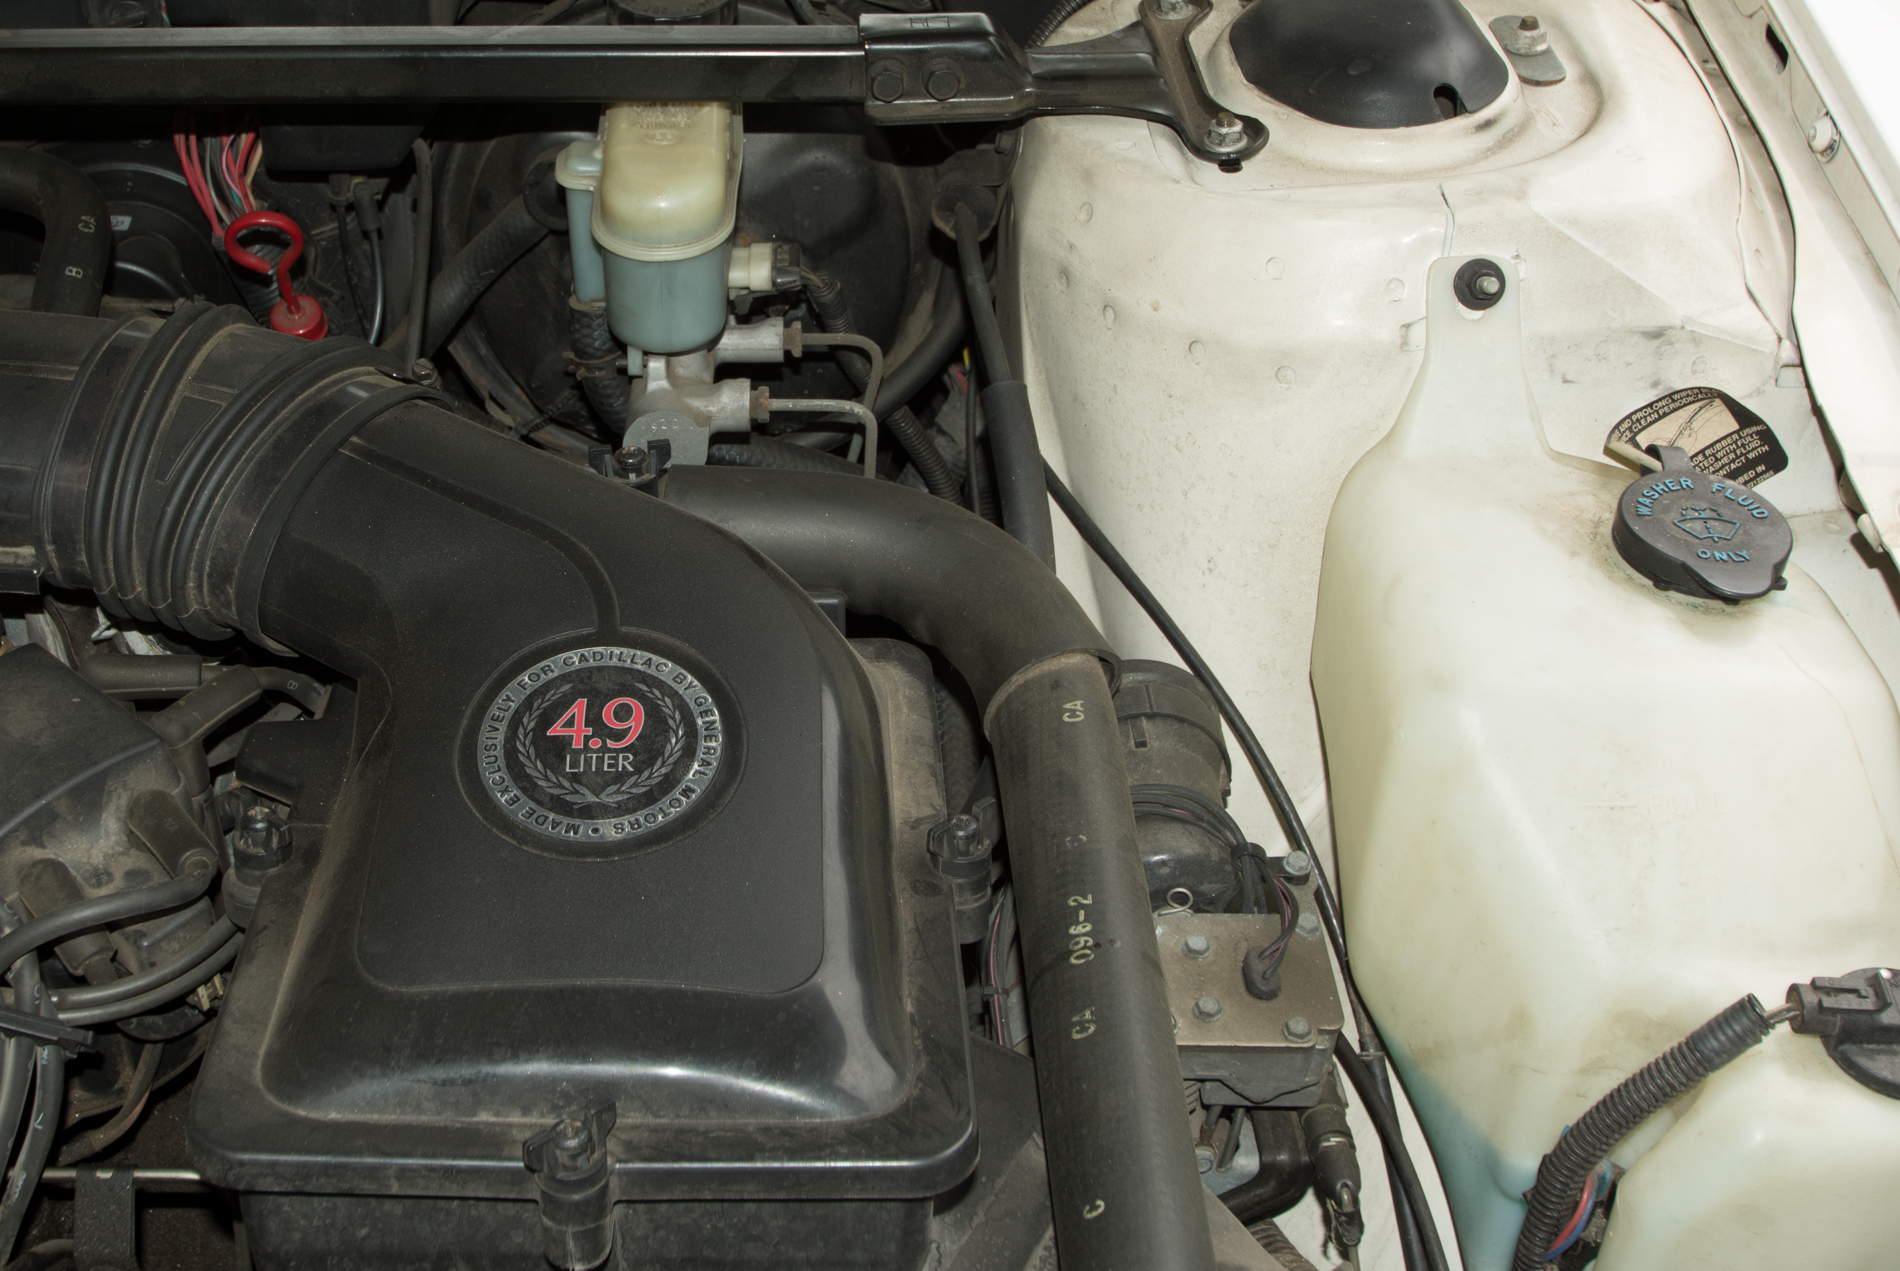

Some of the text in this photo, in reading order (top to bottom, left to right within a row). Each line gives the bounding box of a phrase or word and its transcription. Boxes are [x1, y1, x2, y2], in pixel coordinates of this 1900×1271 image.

[1632, 396, 1672, 422] PROLONG
[1671, 388, 1700, 401] WIPER
[1632, 411, 1659, 432] CLEAN
[1658, 392, 1718, 416] PERIODICALLY
[1704, 433, 1740, 457] RUBBER
[1739, 424, 1767, 437] USING
[1715, 443, 1737, 459] WITH
[1737, 433, 1760, 447] FULL
[1736, 439, 1764, 456] FLUID.
[1746, 444, 1770, 460] WITH
[1755, 463, 1766, 474] IN
[1636, 477, 1769, 519] WASHER FLUID
[1696, 548, 1751, 563] ONLY
[546, 697, 645, 749] 4.9
[1062, 700, 1085, 722] CA
[483, 649, 721, 837] MADE EXCLUSIVELY FOR CADILLAC BY GENERAL MOTORS
[565, 753, 635, 773] LITER
[1067, 893, 1095, 965] 096-2
[1071, 1006, 1097, 1040] CA
[1083, 1199, 1105, 1219] C
